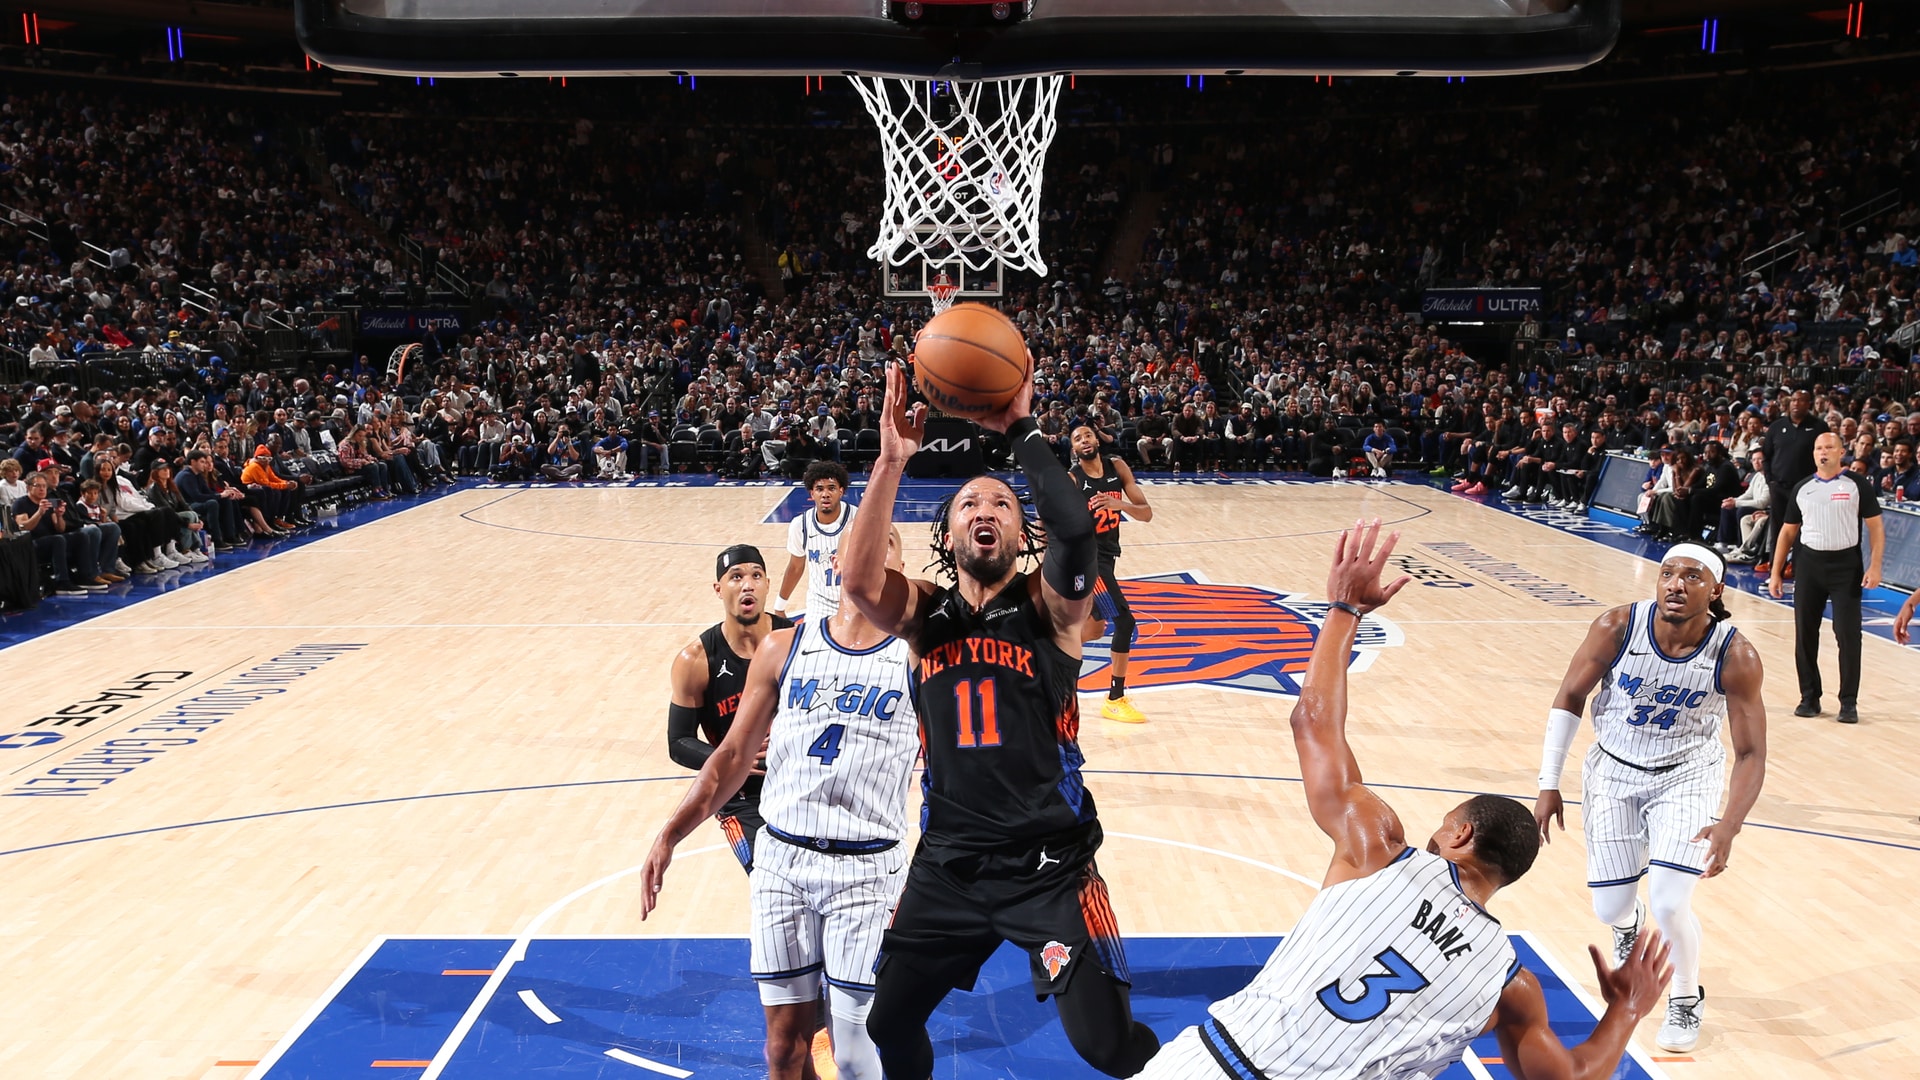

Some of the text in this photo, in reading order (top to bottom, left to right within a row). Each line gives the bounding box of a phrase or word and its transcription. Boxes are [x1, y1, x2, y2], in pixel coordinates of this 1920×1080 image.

[362, 316, 407, 330] Michelob
[1422, 296, 1540, 312] Michelob ULTRA
[923, 376, 993, 412] Wilson
[1094, 508, 1120, 534] 25
[921, 637, 1034, 684] NEW YORK
[0, 643, 369, 797] MADISON SQUARE GARDEN
[24, 671, 193, 727] CHASE
[954, 676, 1002, 749] 11
[1626, 705, 1680, 730] 34
[807, 723, 846, 766] 4
[1410, 899, 1472, 962] BANE
[1316, 945, 1431, 1024] 3
